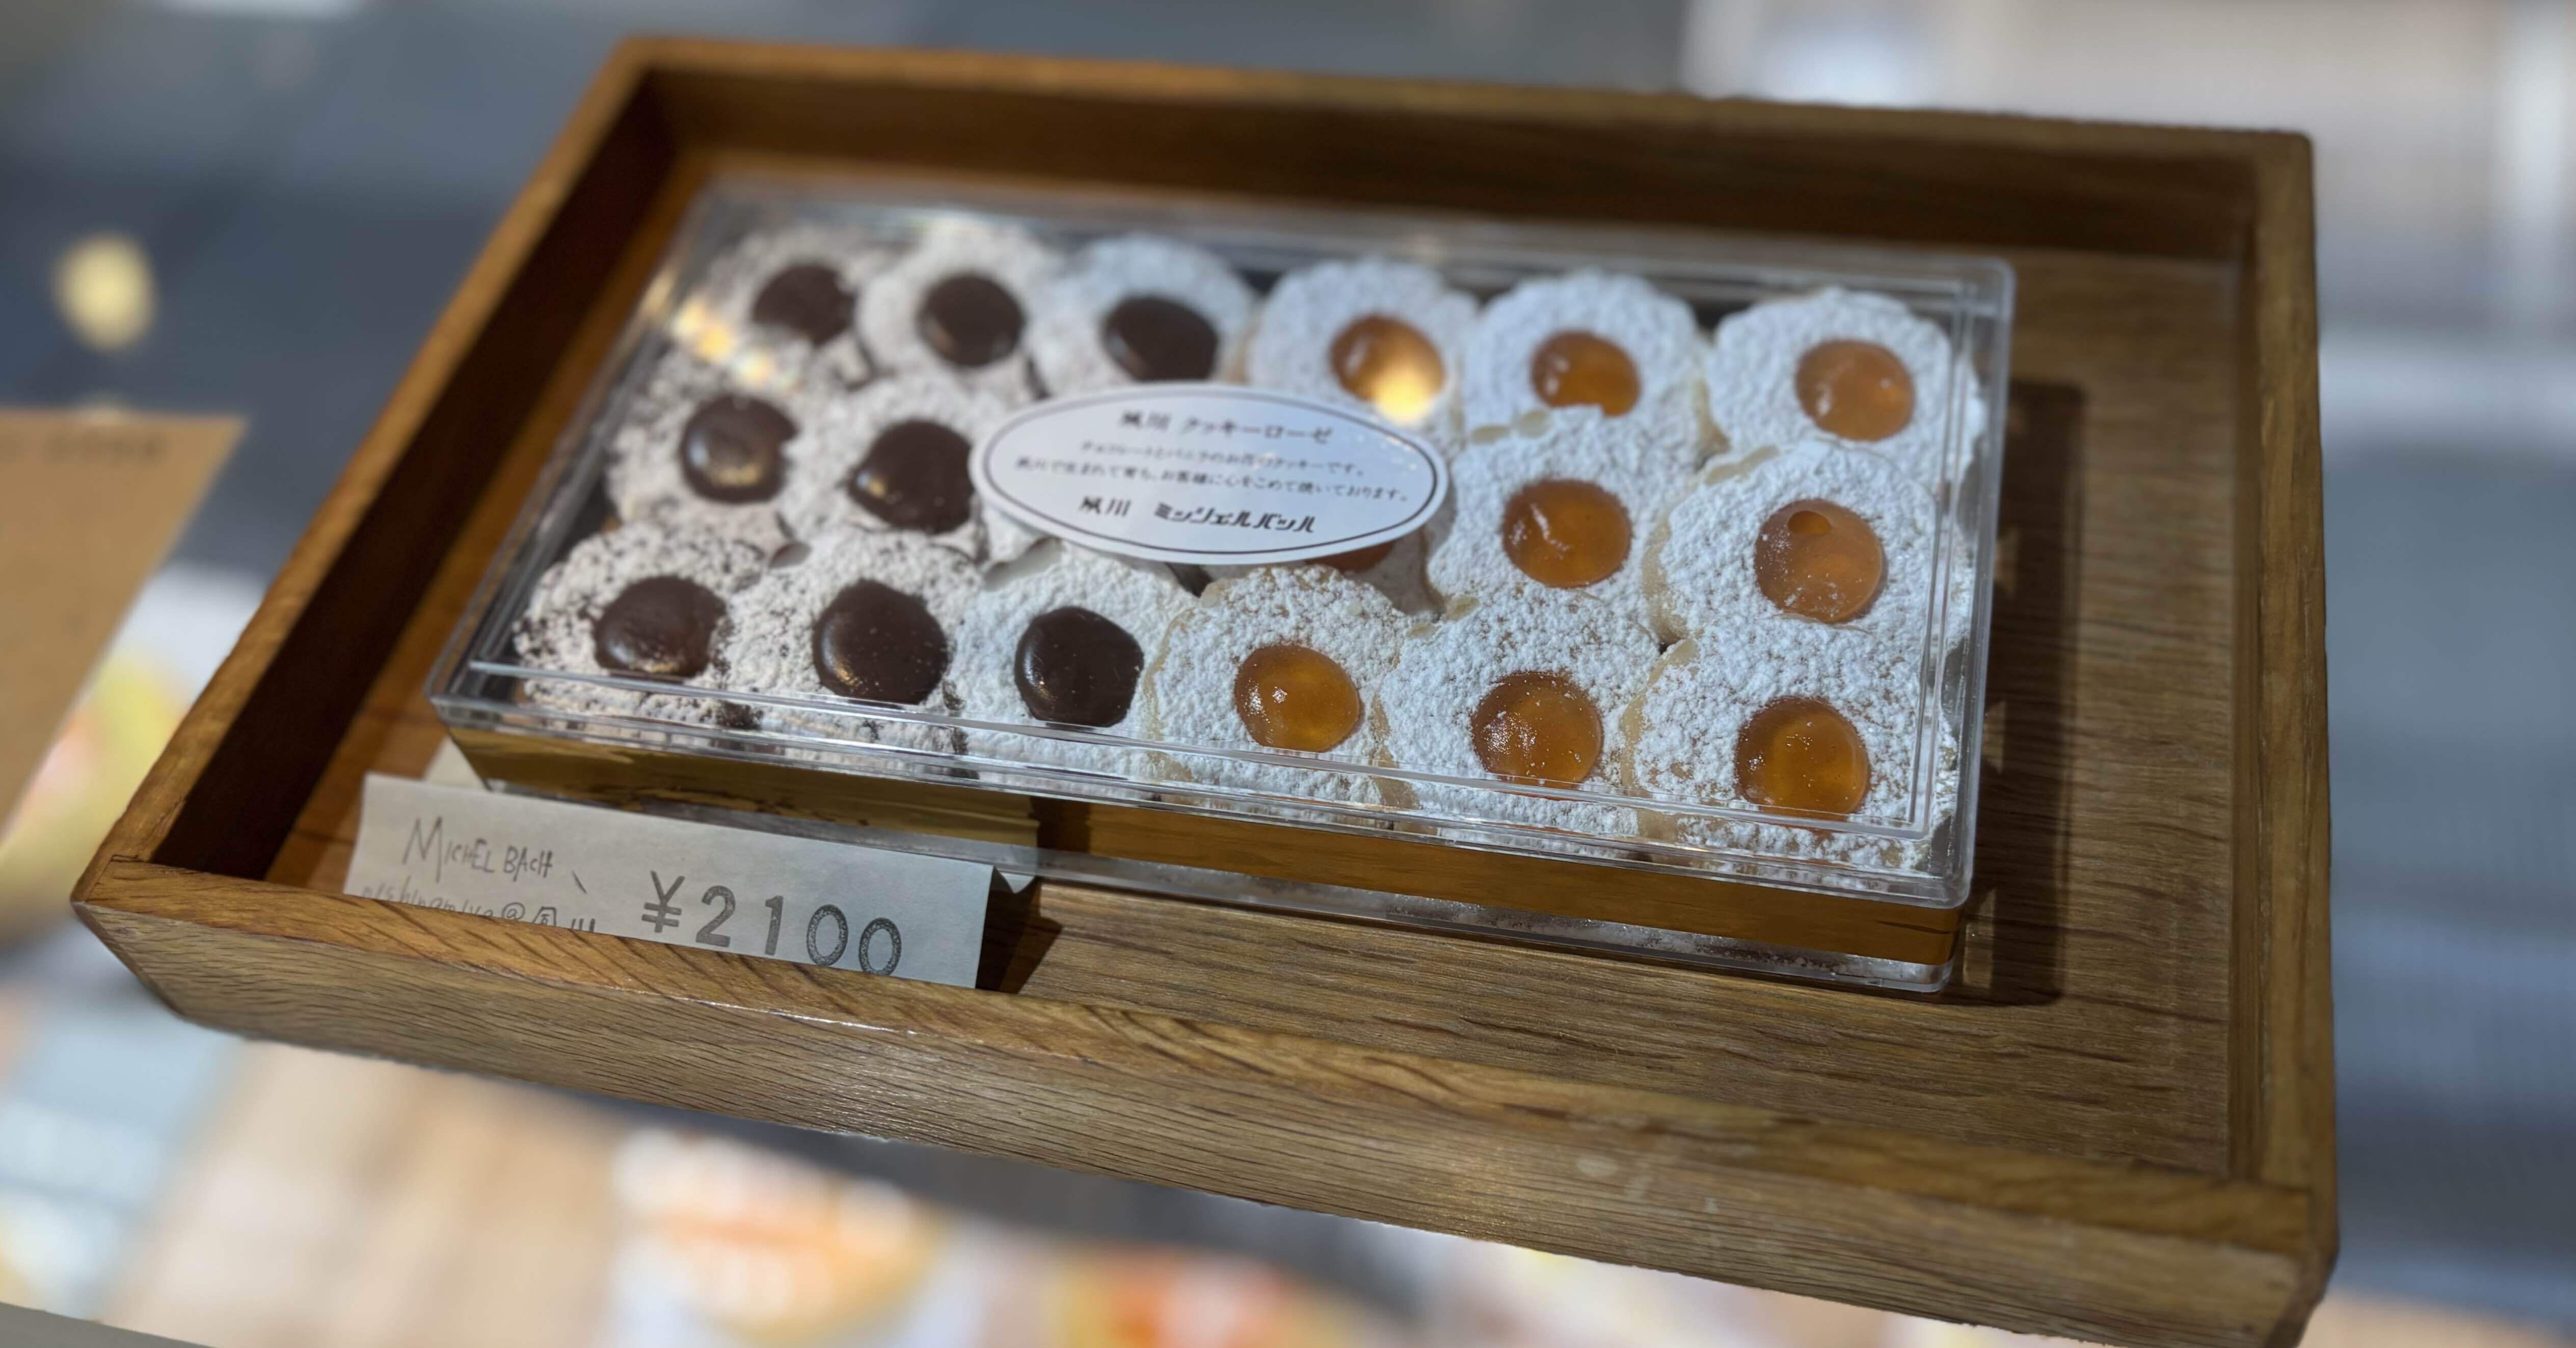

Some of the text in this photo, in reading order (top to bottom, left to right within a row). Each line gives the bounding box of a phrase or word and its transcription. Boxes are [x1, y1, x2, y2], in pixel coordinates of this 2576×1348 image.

[1179, 416, 1333, 443] クッキーローゼ
[402, 816, 553, 883] MICHEL BACH
[641, 870, 902, 977] ¥2100
